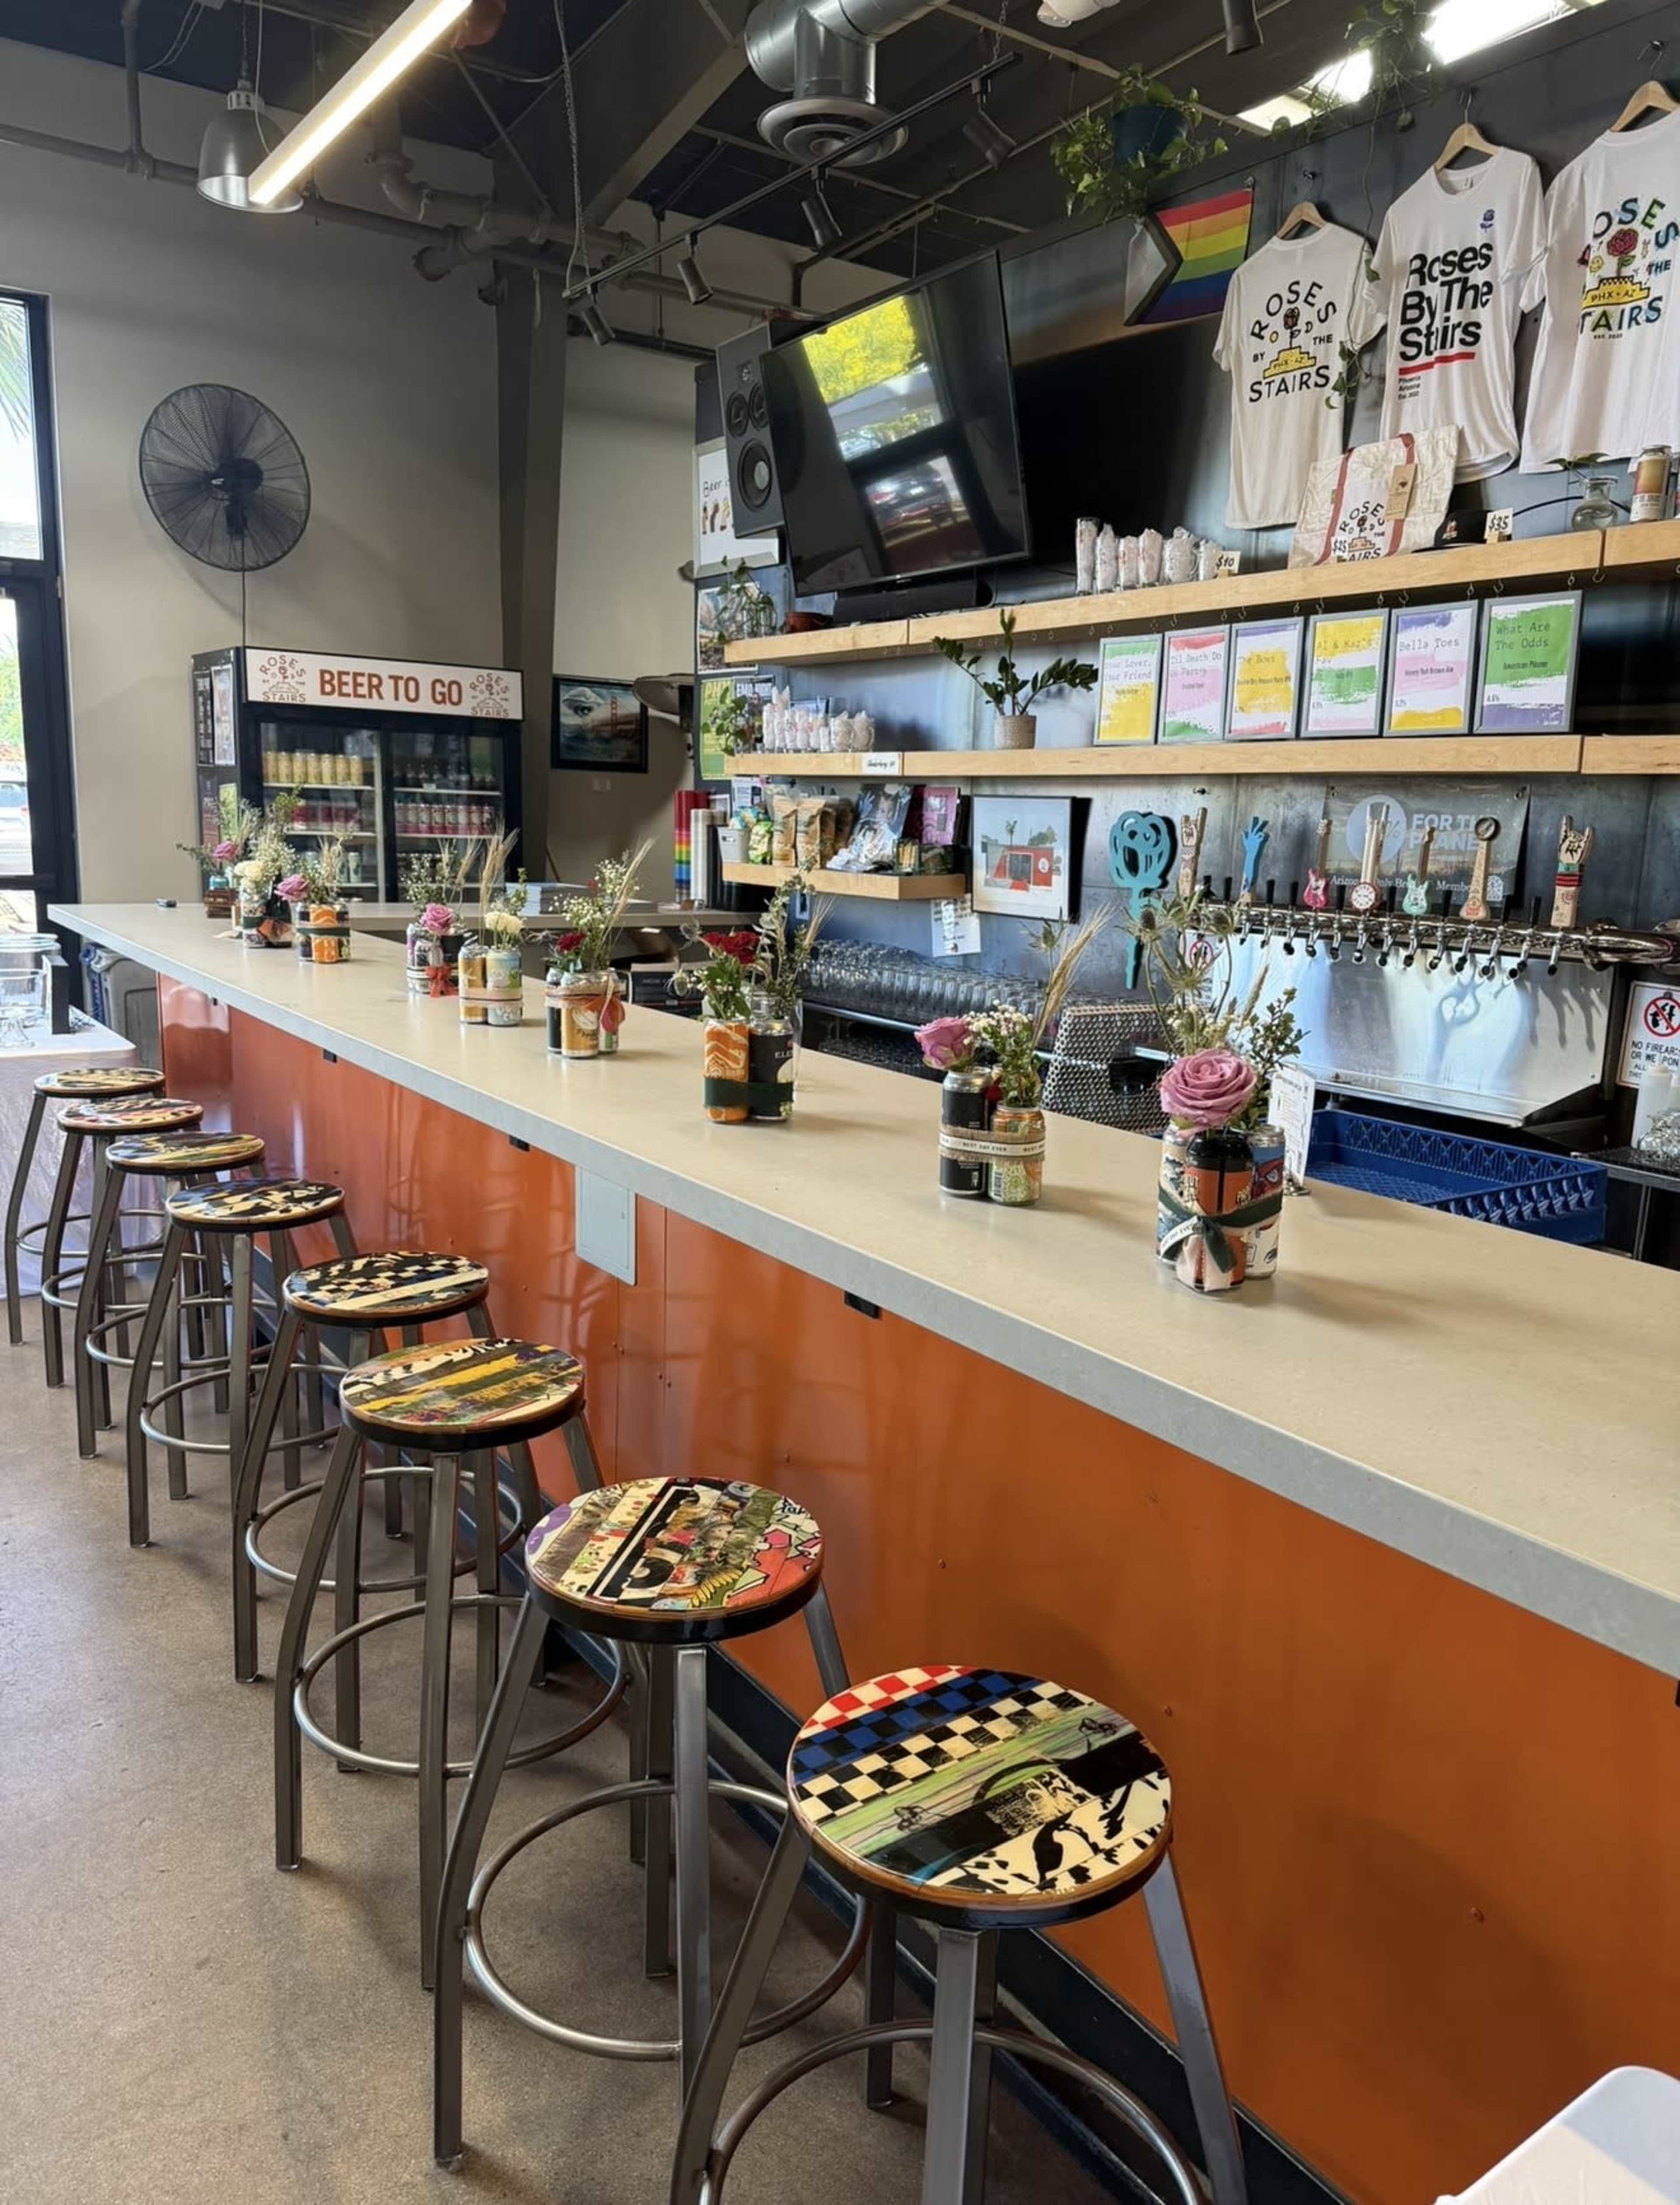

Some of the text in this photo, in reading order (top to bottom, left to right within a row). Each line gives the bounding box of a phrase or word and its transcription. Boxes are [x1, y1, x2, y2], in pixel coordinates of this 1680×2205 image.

[1648, 259, 1672, 275] THE
[1400, 276, 1494, 331] By The
[1591, 292, 1615, 302] PHX
[1250, 280, 1337, 340] ROSES
[1580, 296, 1662, 334] TAIRS
[1313, 334, 1333, 345] THE
[1253, 352, 1265, 362] BY
[1249, 365, 1330, 403] STAIRS
[1489, 514, 1508, 532] $35
[1216, 555, 1234, 569] $10
[1496, 622, 1550, 635] What Are
[1399, 638, 1460, 651] Bella Toes
[1495, 638, 1548, 650] The Odds
[1212, 651, 1222, 661] Do
[259, 655, 306, 677] ROSES
[319, 669, 462, 706] BEER TO GO
[469, 673, 509, 694] ROSES
[262, 691, 306, 702] STAIRS
[471, 706, 509, 717] STAIRS
[1412, 814, 1452, 831] FOR
[1631, 1040, 1643, 1049] NO
[1631, 1050, 1642, 1061] OR
